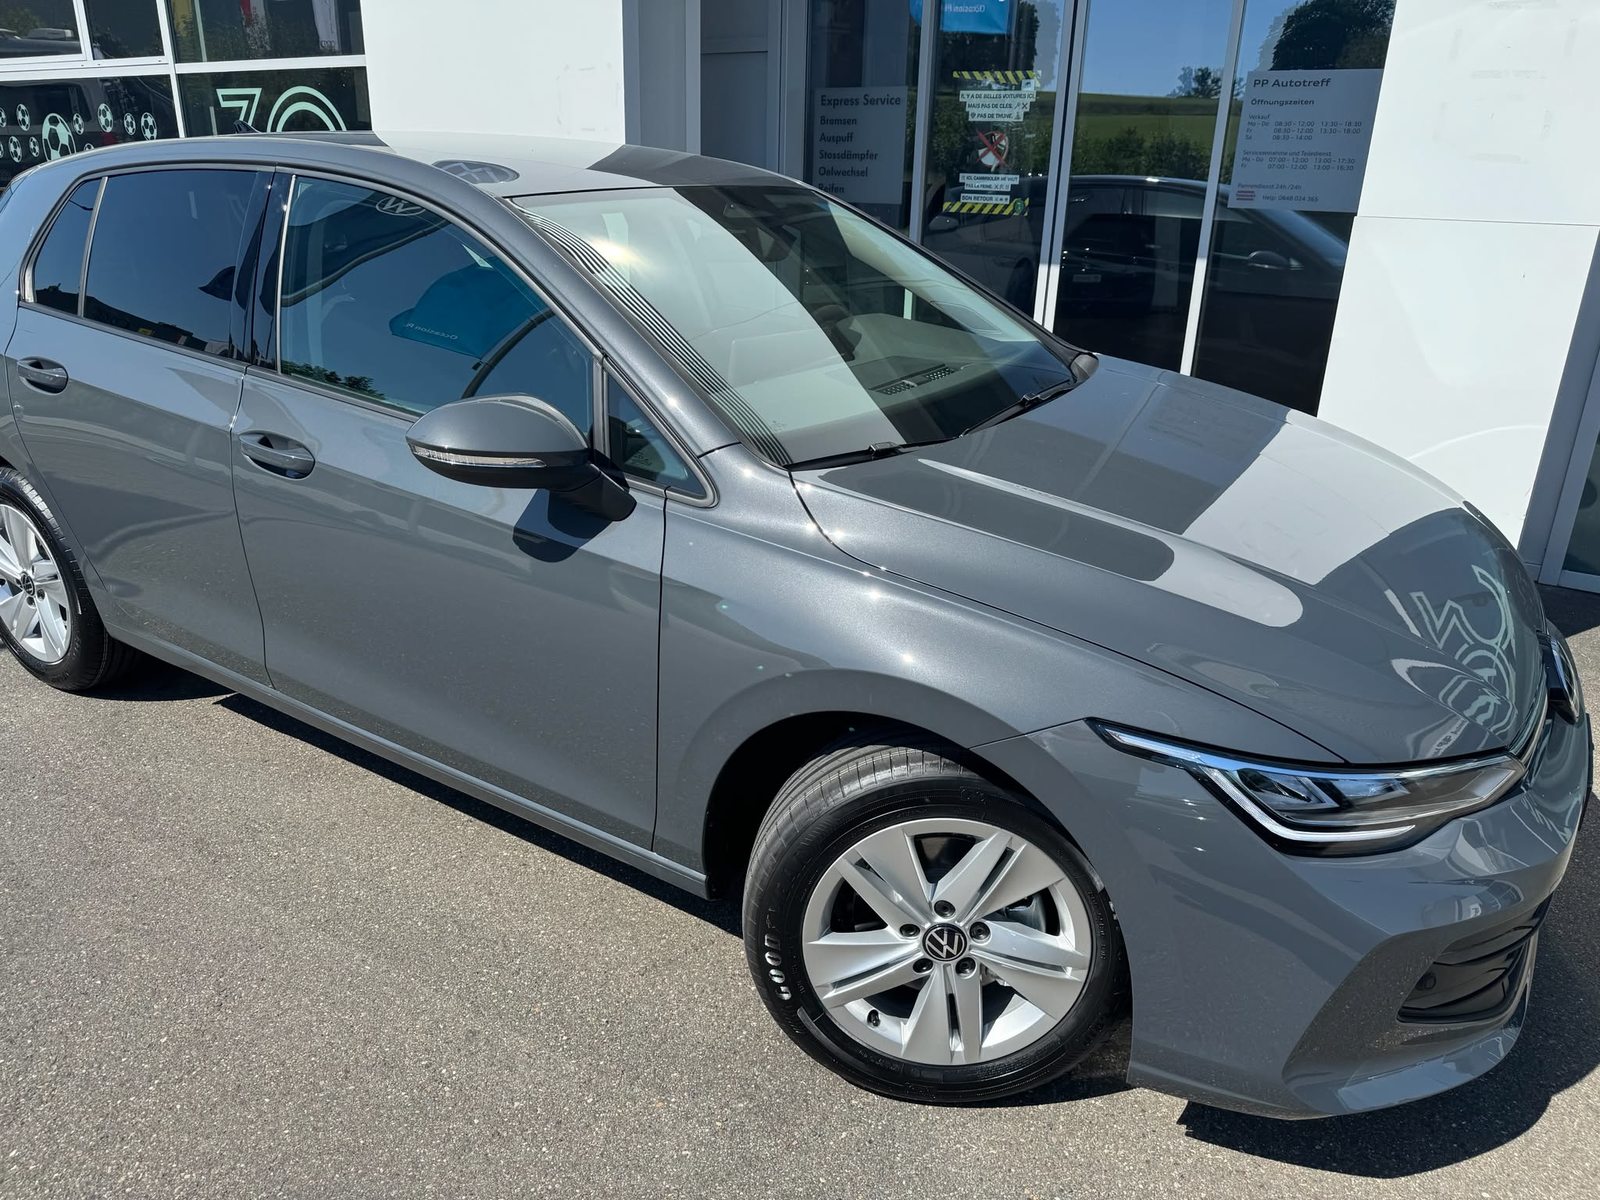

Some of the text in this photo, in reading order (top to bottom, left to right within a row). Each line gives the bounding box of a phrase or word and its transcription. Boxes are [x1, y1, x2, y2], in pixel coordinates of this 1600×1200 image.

[1253, 78, 1331, 88] PP Autotreff
[821, 94, 901, 109] Express Service
[1250, 98, 1315, 107] Öffnungszeiten
[820, 115, 857, 126] Bremsen
[819, 132, 854, 145] Auspuff
[819, 149, 879, 161] Stossdämpfer
[818, 166, 868, 177] Oelwechsel
